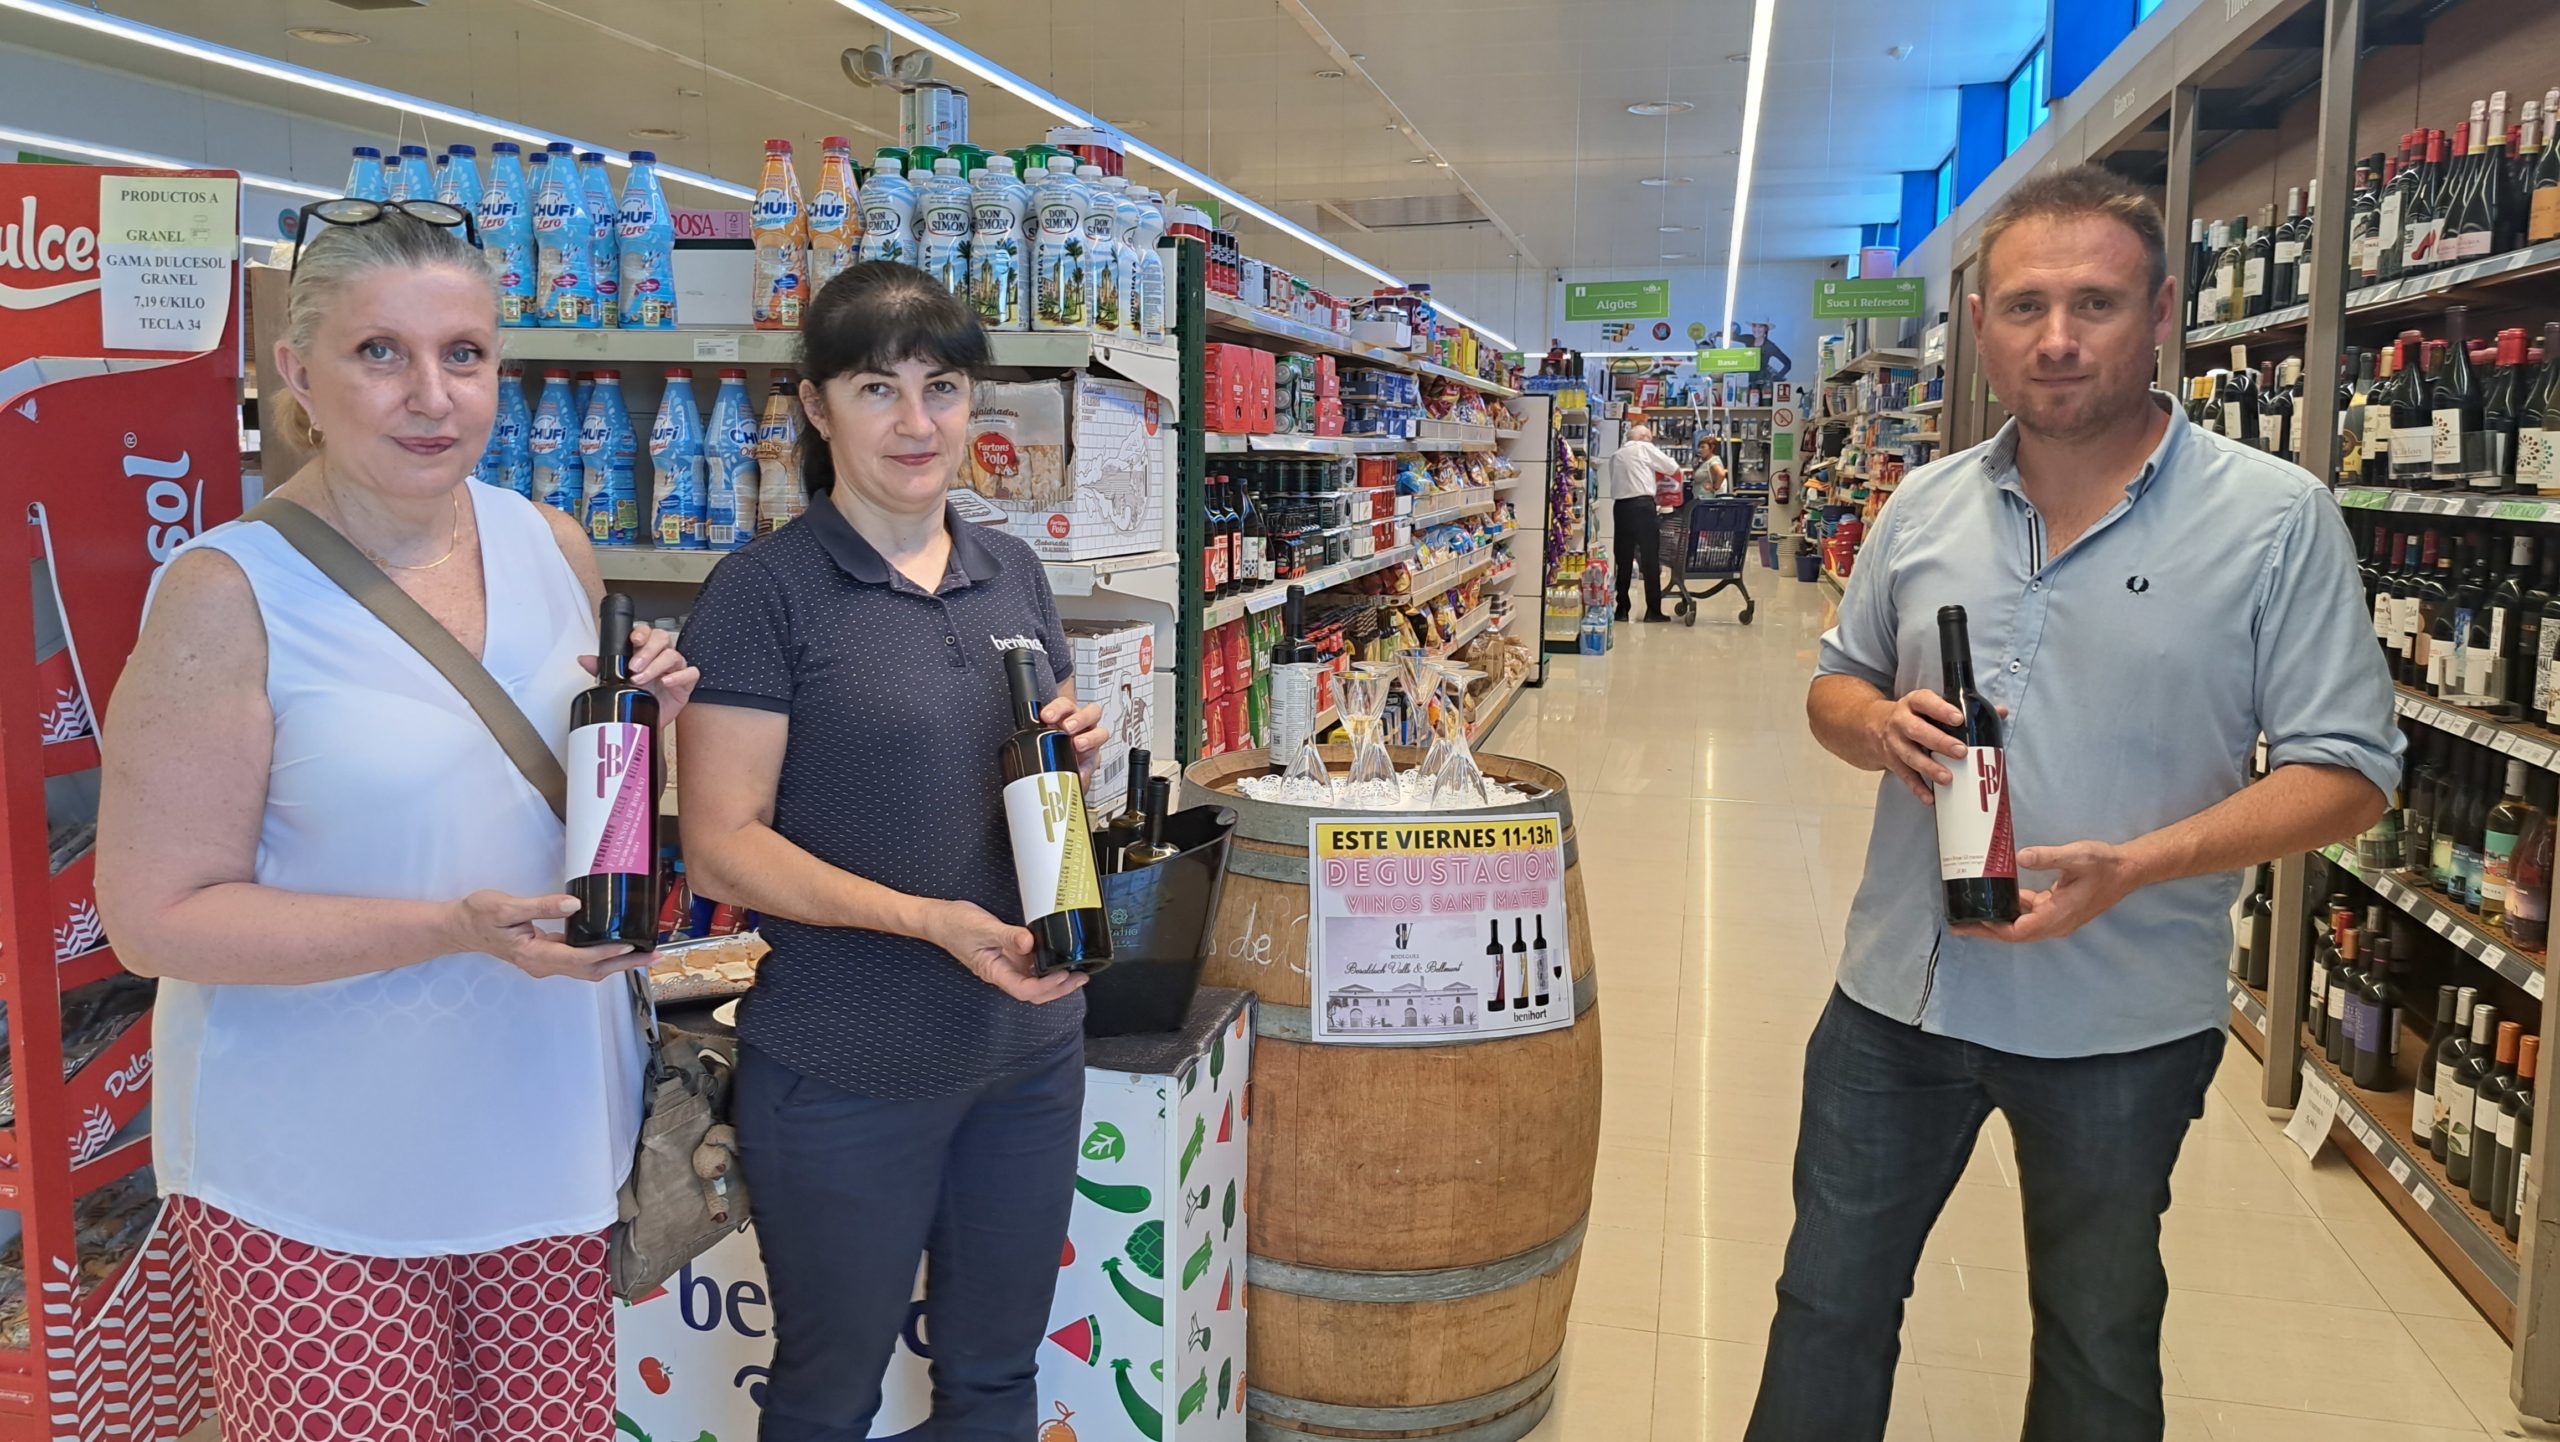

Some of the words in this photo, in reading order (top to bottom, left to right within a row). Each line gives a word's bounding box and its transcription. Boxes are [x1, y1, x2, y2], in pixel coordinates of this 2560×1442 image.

[121, 189, 207, 203] PRODUCTOS
[209, 193, 219, 204] A
[937, 212, 961, 222] DON
[1049, 209, 1067, 218] DON
[480, 217, 505, 230] Zero
[536, 217, 562, 230] Zero
[931, 221, 967, 232] SIMON
[1045, 218, 1074, 229] SIMON
[126, 229, 185, 243] GRANEL
[620, 224, 646, 238] Zero
[106, 255, 152, 268] GAMA
[155, 256, 226, 269] DULCESOL
[141, 273, 198, 286] GRANEL
[134, 296, 157, 308] 7,19
[160, 296, 205, 310] €/KILO
[1596, 299, 1638, 312] Aigües
[1827, 298, 1850, 308] Sucs
[1860, 298, 1910, 308] Refrescos
[139, 318, 184, 331] TECLA
[187, 319, 201, 331] 34
[977, 442, 1010, 452] Fartons
[982, 451, 1009, 465] Polo
[1051, 524, 1067, 534] Polo
[1332, 830, 1388, 850] ESTE
[1395, 828, 1496, 850] VIERNES
[1502, 825, 1553, 847] 11-13h
[1325, 846, 1558, 888] DEGUSTACIÓN
[1345, 893, 1423, 914] VINOS
[1431, 891, 1488, 913] SANT
[1493, 887, 1549, 911] MATEU
[1413, 962, 1422, 974] &
[1513, 1009, 1548, 1023] benihort
